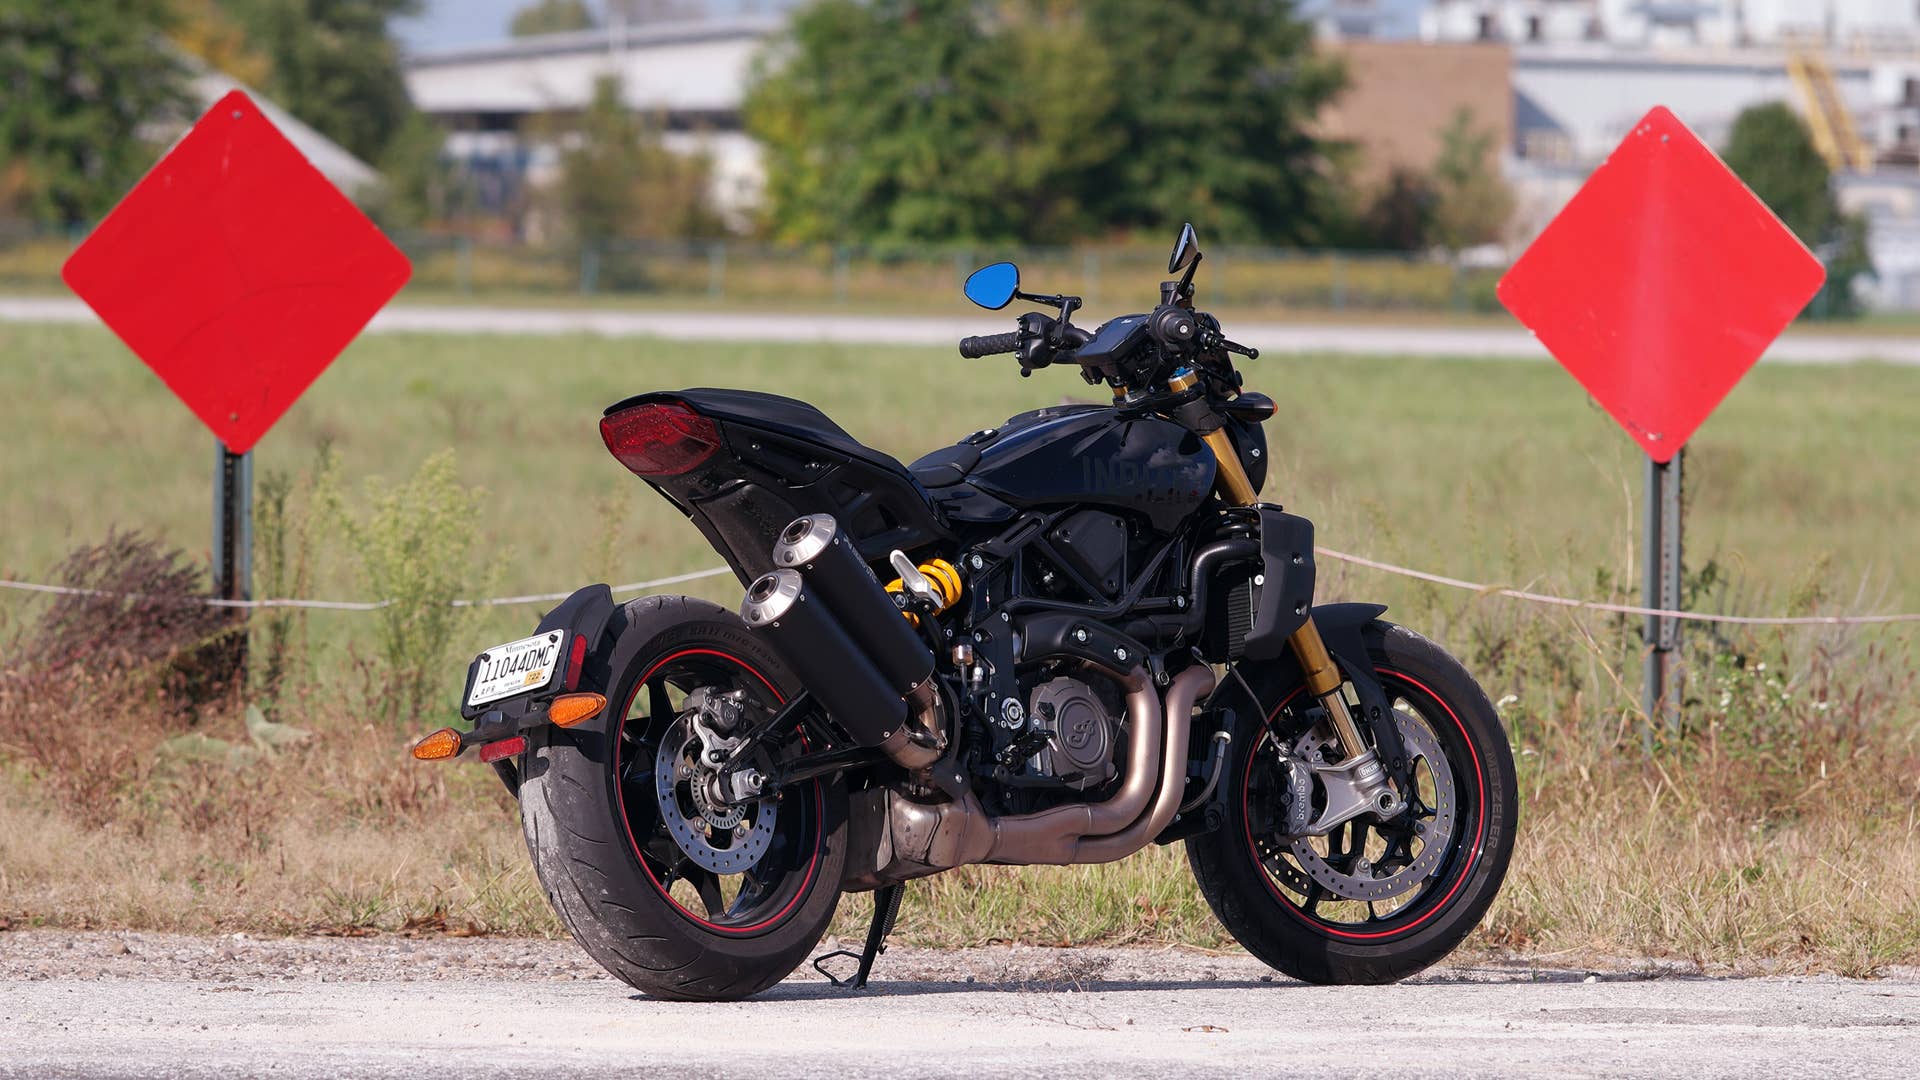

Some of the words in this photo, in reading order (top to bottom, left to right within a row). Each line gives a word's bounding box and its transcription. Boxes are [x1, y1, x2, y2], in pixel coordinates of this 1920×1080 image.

[481, 644, 555, 684] 11044DMC
[505, 640, 541, 654] Minnesota
[1296, 778, 1306, 820] brembo
[1486, 751, 1503, 849] METZELER
